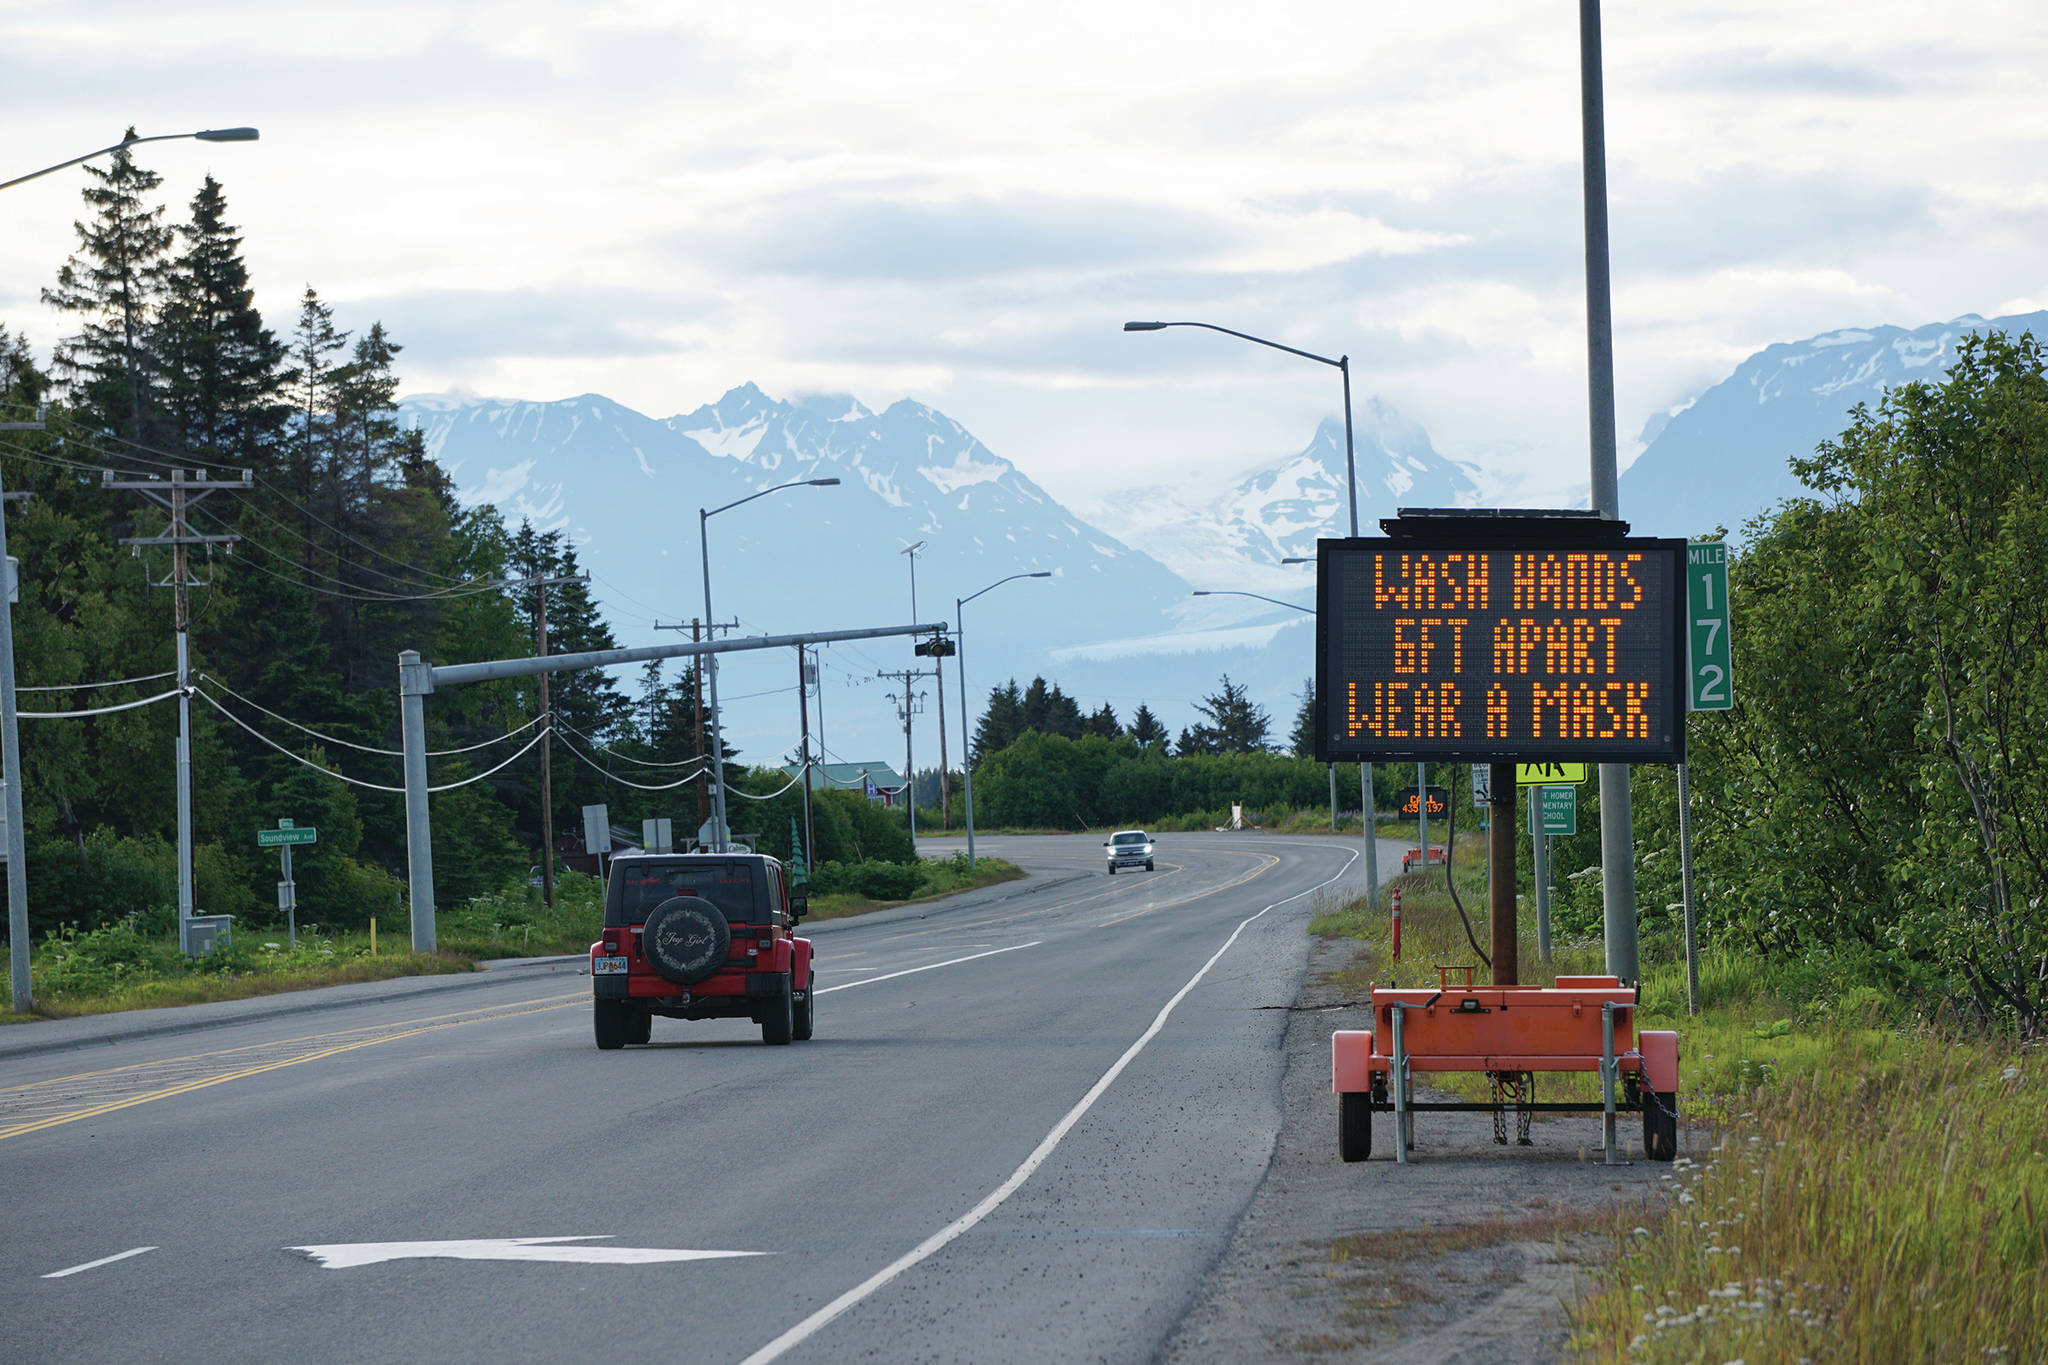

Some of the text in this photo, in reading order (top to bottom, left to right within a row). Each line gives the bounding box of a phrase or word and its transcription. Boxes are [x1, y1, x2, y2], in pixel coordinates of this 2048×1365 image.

[1688, 548, 1725, 565] MILE
[1375, 553, 1642, 609] WASH HANDS
[1395, 618, 1622, 674] 6FT APART
[1696, 573, 1725, 702] 172
[1348, 682, 1648, 738] WEAR A MASK
[1550, 791, 1573, 800] HOMER
[1543, 811, 1565, 820] CHOOL
[260, 833, 300, 844] Soundview
[685, 934, 710, 948] Girl
